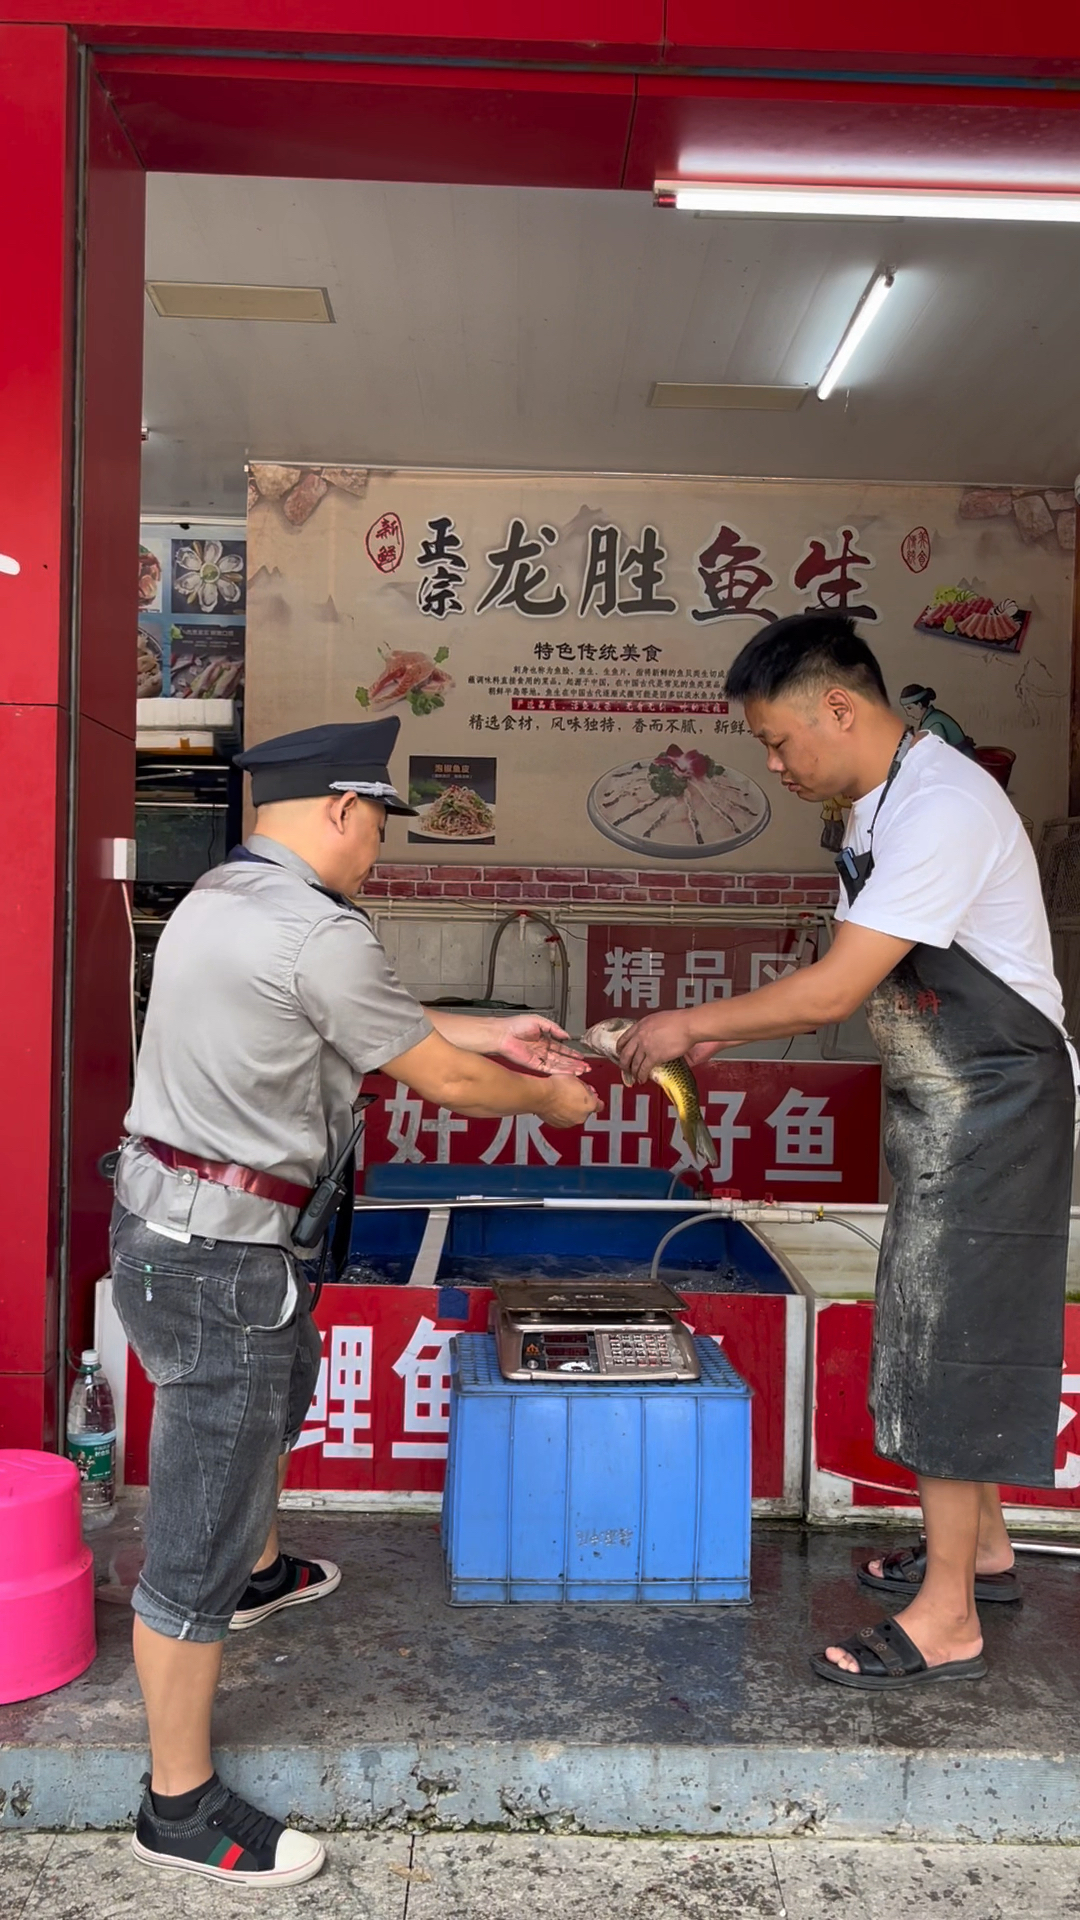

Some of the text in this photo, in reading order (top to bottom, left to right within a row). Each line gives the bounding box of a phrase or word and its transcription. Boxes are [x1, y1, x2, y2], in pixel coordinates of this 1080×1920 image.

[416, 516, 467, 617] 正宗
[476, 519, 878, 624] 龙胜鱼生
[533, 641, 663, 663] 特色传统美食
[469, 714, 753, 735] 精选食材，风味独特，香而不腻，新鲜
